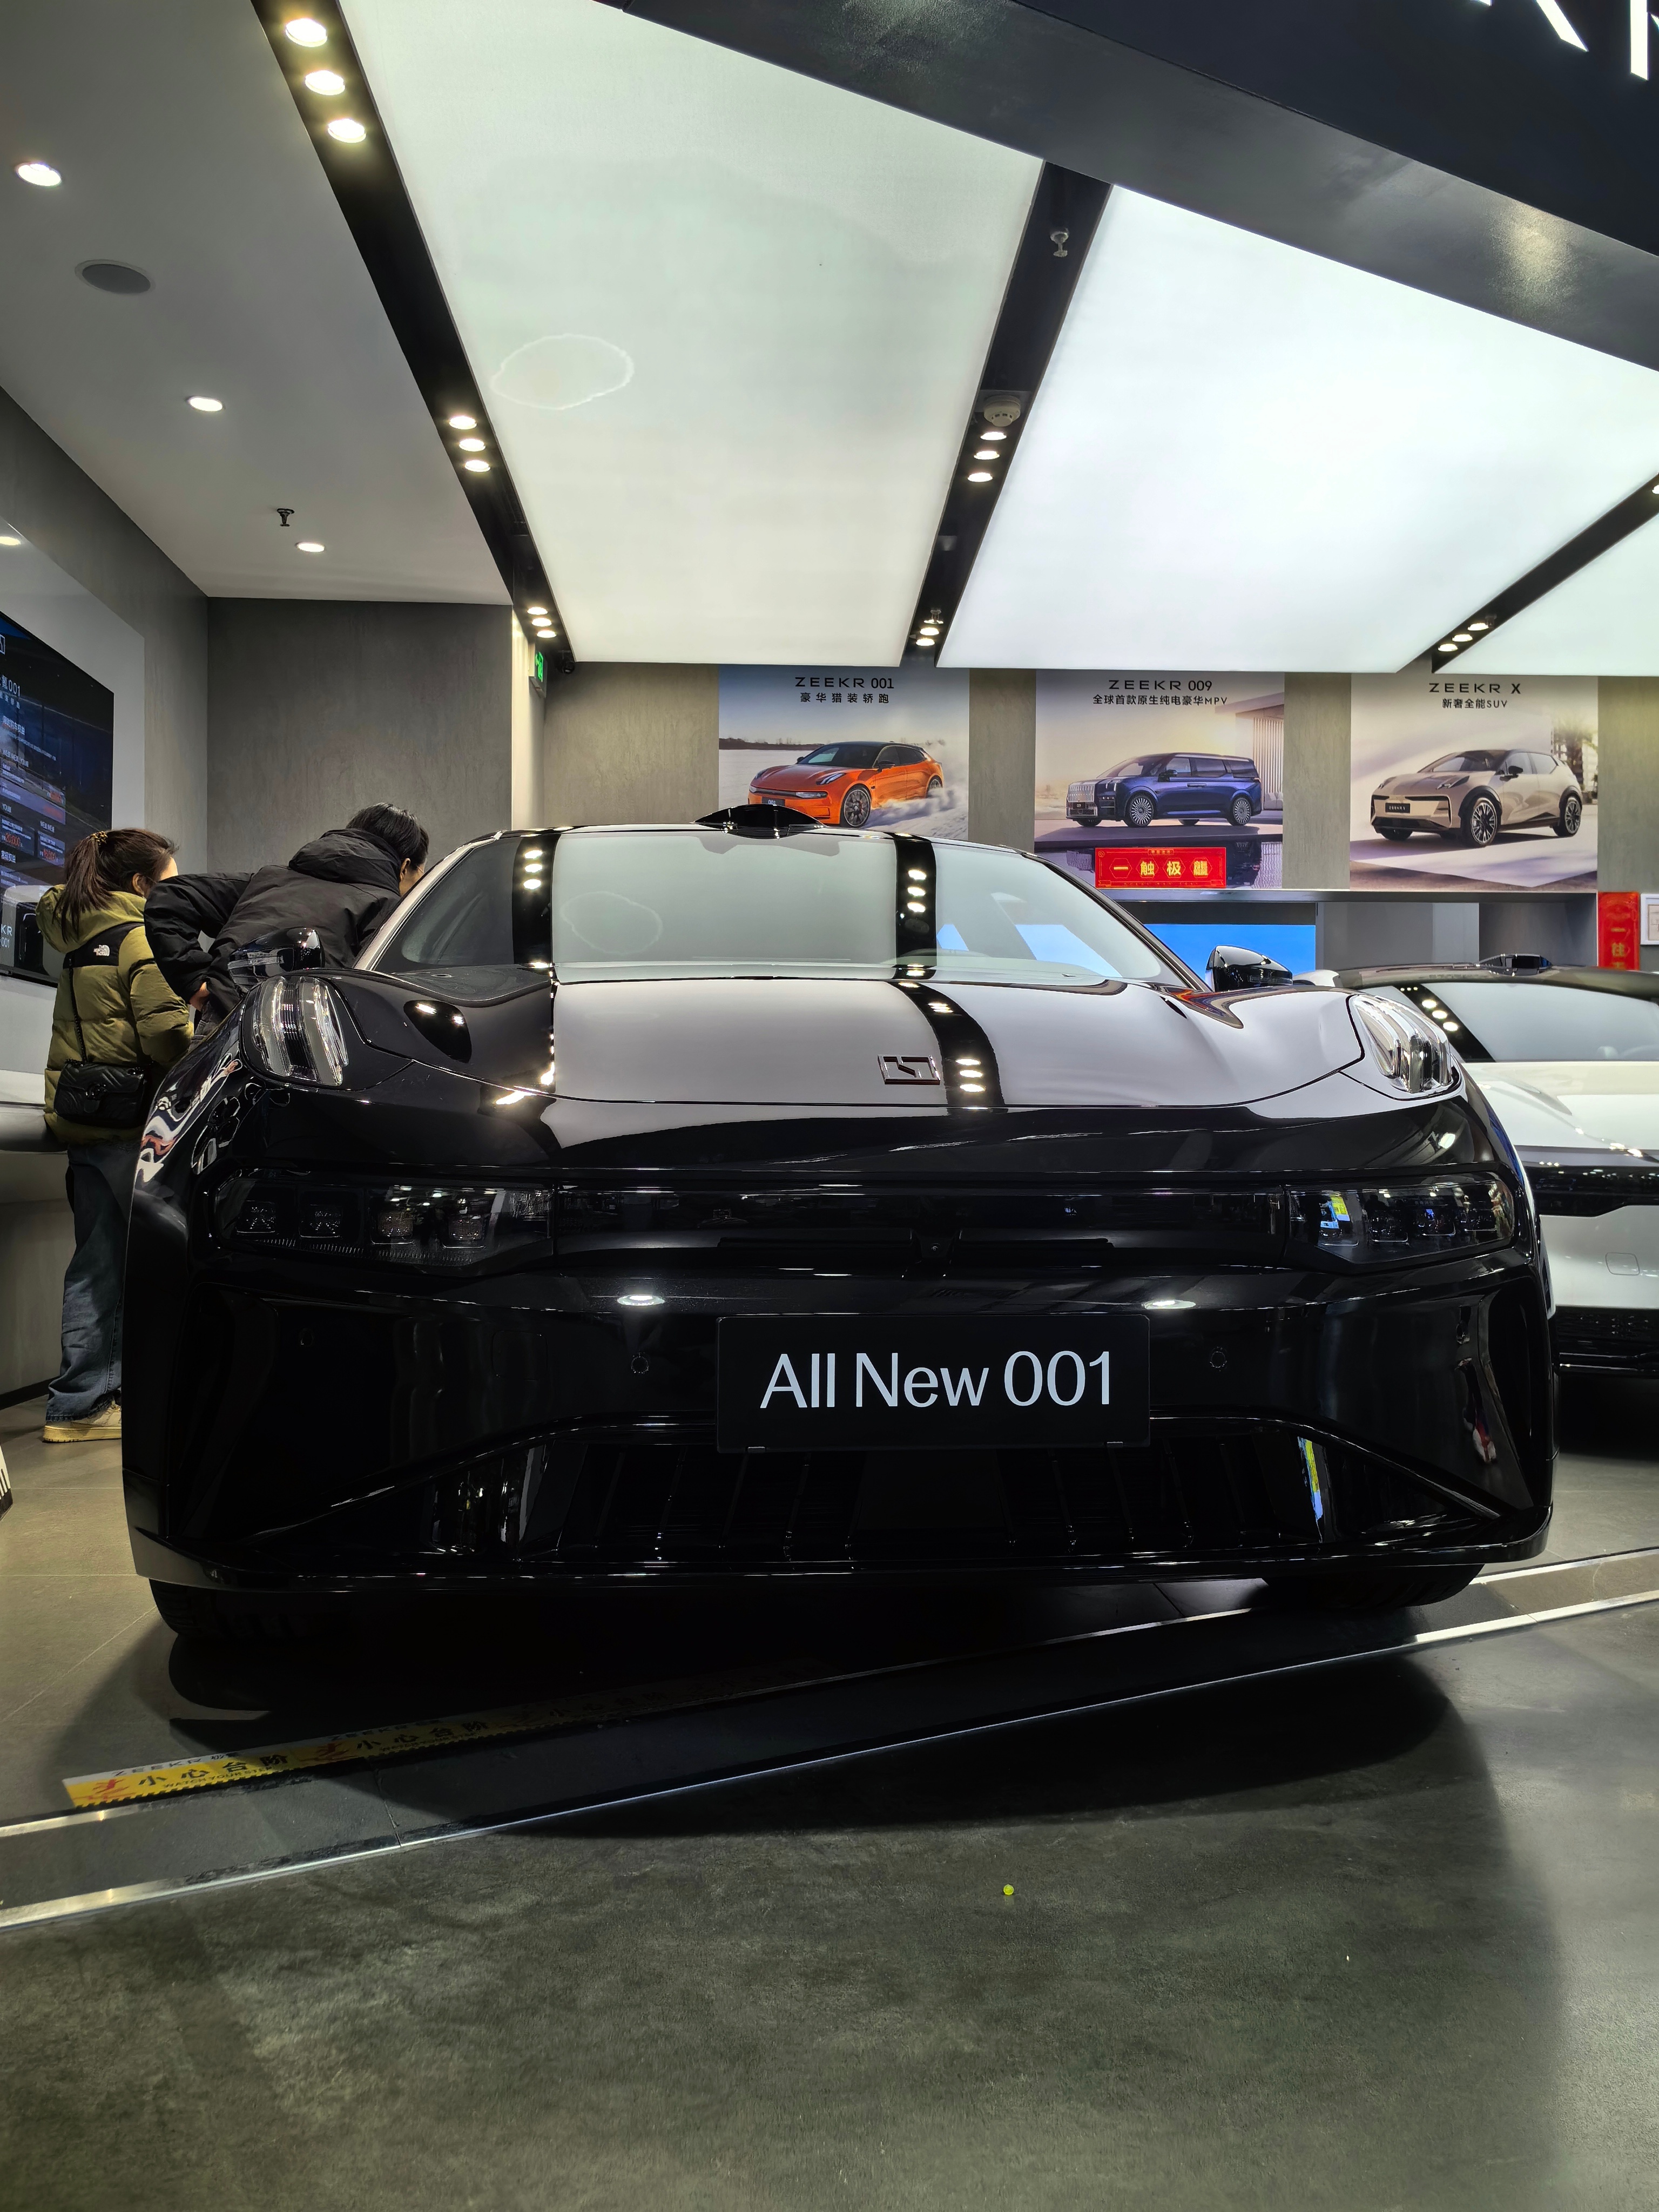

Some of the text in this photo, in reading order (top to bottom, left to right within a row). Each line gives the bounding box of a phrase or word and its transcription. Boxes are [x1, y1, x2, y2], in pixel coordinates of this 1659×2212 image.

[795, 677, 894, 689] ZEEKR 001
[1109, 680, 1212, 691] ZEEKR 009
[1429, 683, 1521, 694] ZEEKR X
[800, 692, 889, 704] 豪华猎装轿跑
[1092, 694, 1228, 706] 全球首款原生纯电豪华MPV
[1442, 698, 1507, 709] 新奢全能SUV
[760, 1351, 1110, 1408] All New 001
[138, 1755, 288, 1786] 小心台阶
